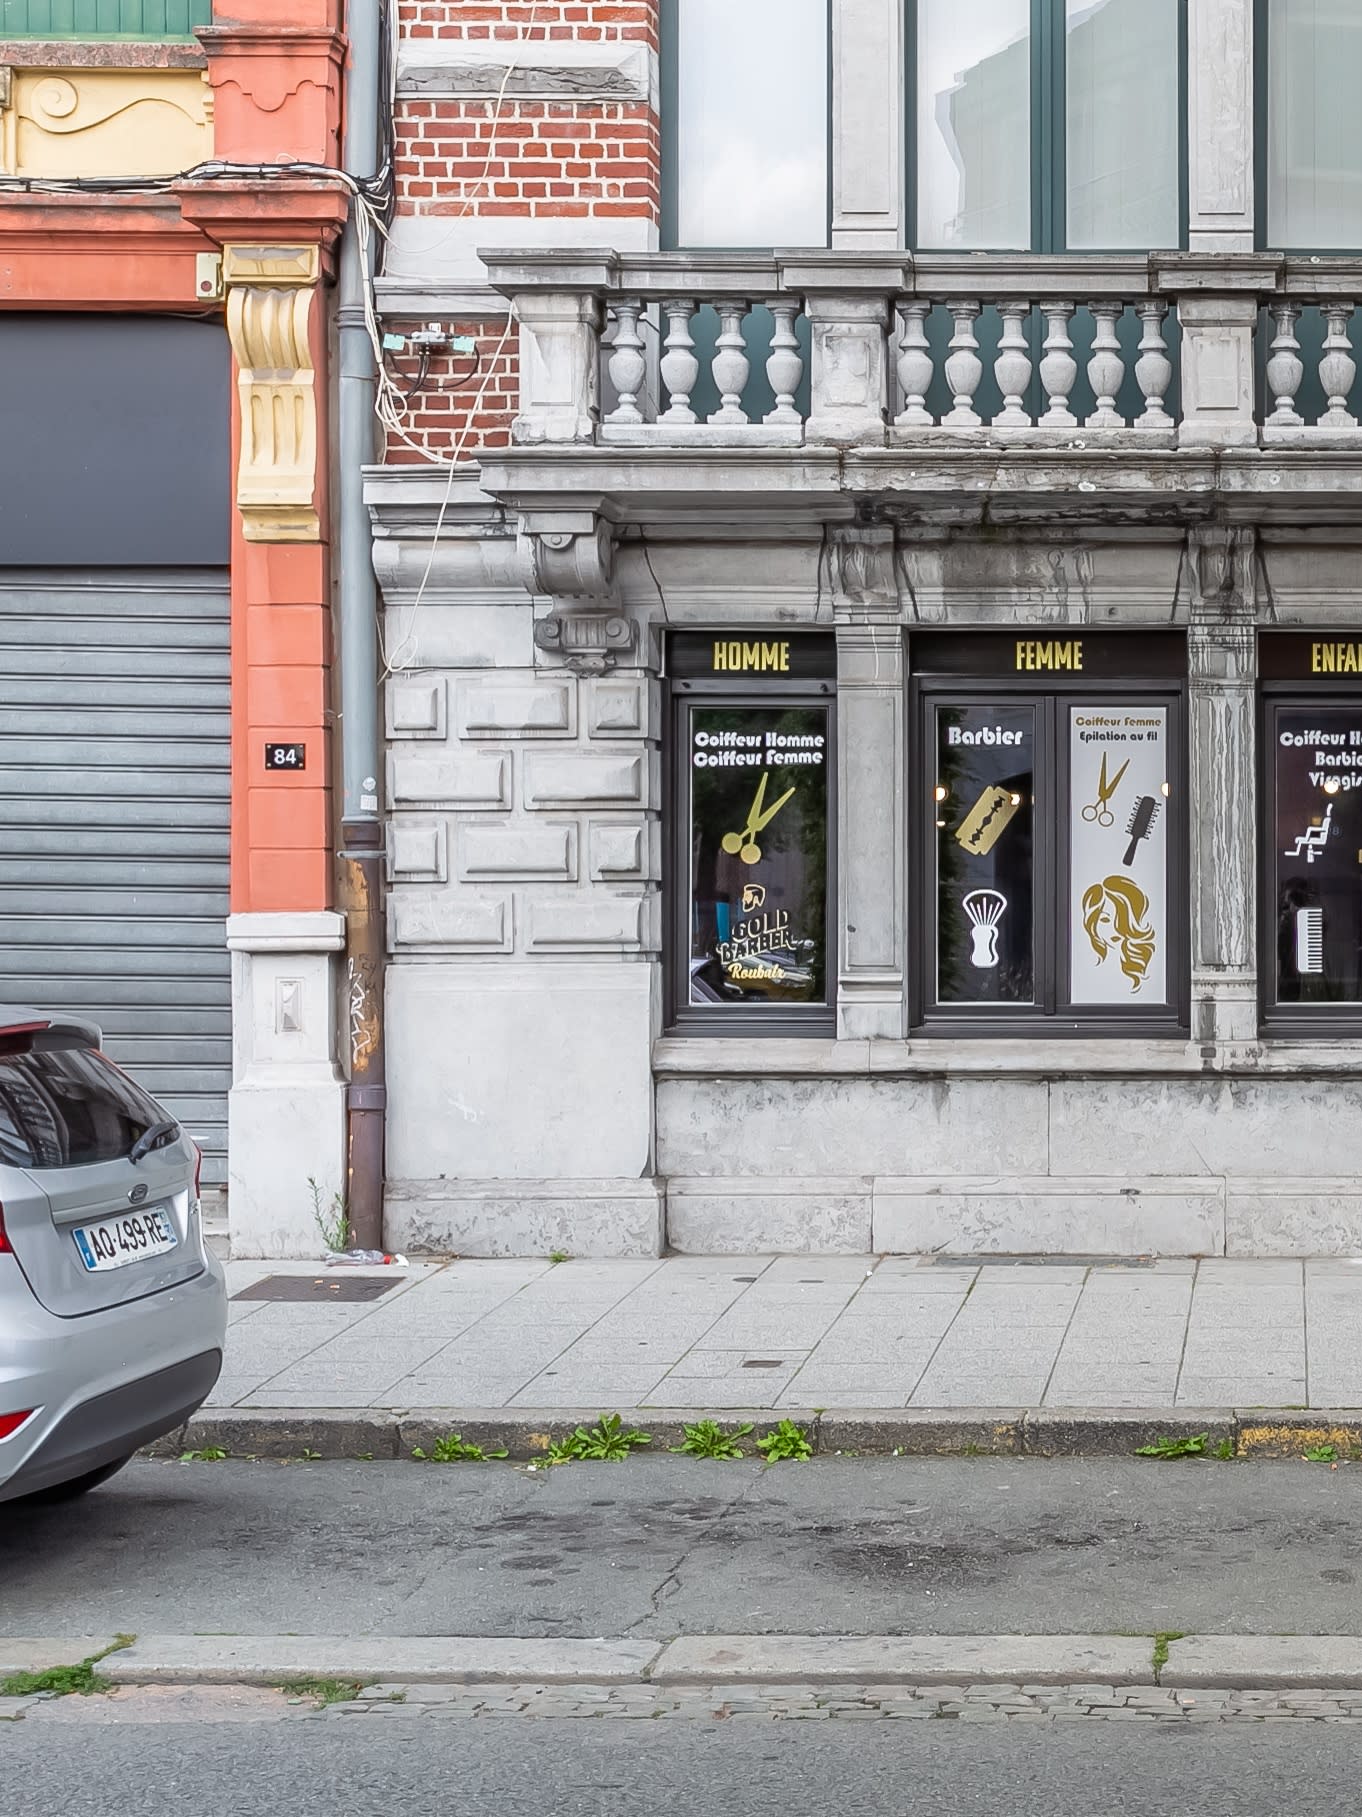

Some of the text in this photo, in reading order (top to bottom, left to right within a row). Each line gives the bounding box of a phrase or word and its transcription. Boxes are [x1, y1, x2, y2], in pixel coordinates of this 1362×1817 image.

[713, 641, 790, 671] HOMME
[1016, 641, 1083, 670] FEMME
[1075, 716, 1162, 726] Coiffeur Femme
[694, 731, 825, 748] Coiffeur Homme
[948, 727, 1023, 745] Barbier
[1079, 731, 1158, 744] Epilation au fil
[1279, 730, 1346, 747] Coiffeur
[274, 749, 297, 765] 84
[693, 749, 823, 767] Coiffeur Femme
[732, 908, 790, 943] GOLD
[716, 930, 797, 966] BARBER
[727, 961, 786, 979] Roubaix
